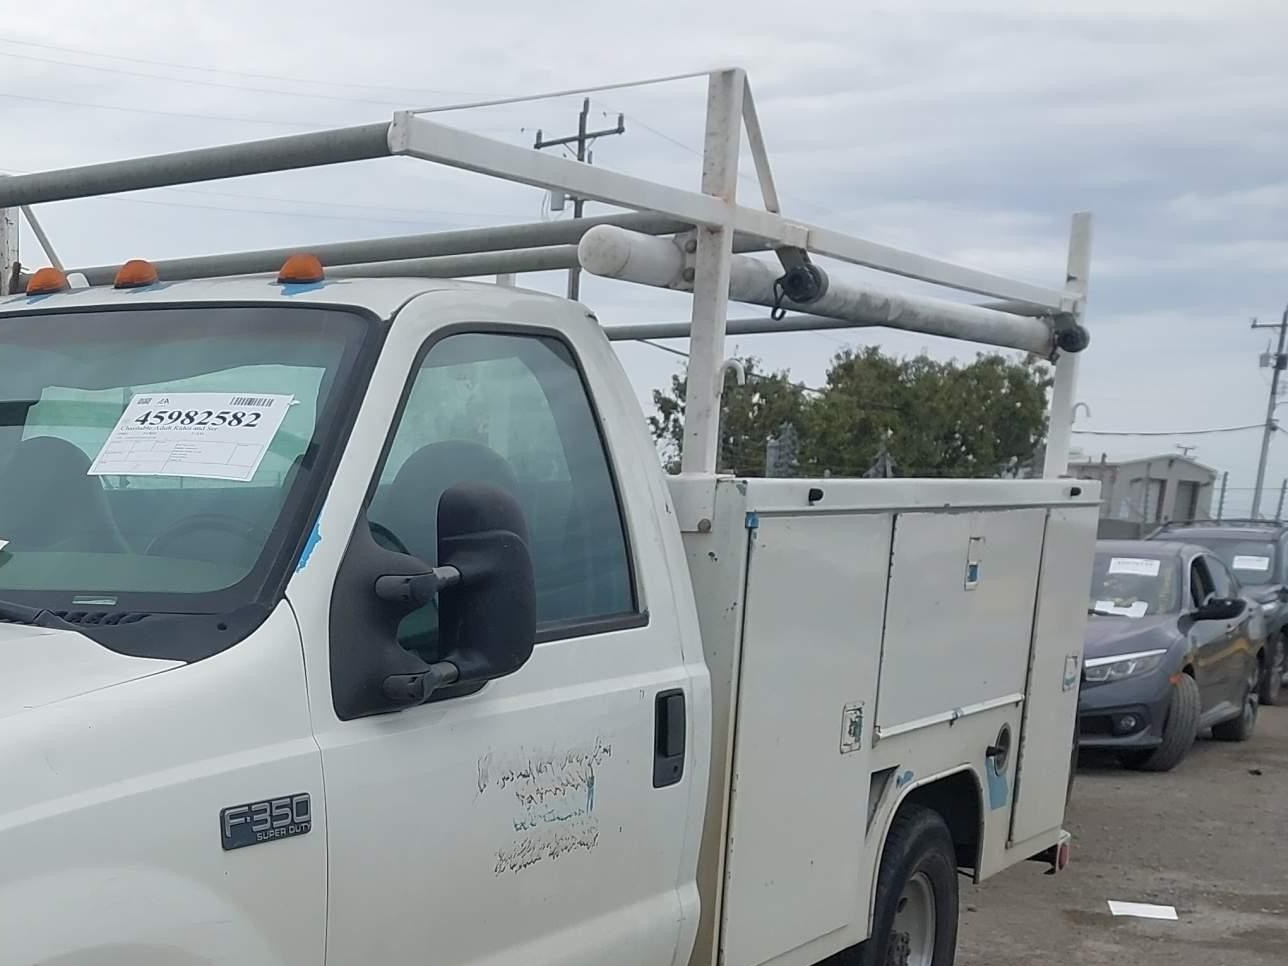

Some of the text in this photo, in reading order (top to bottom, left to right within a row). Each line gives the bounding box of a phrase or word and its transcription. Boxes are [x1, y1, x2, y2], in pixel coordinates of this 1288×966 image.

[134, 410, 262, 427] 45982582
[256, 822, 311, 841] SUPER DUTY
